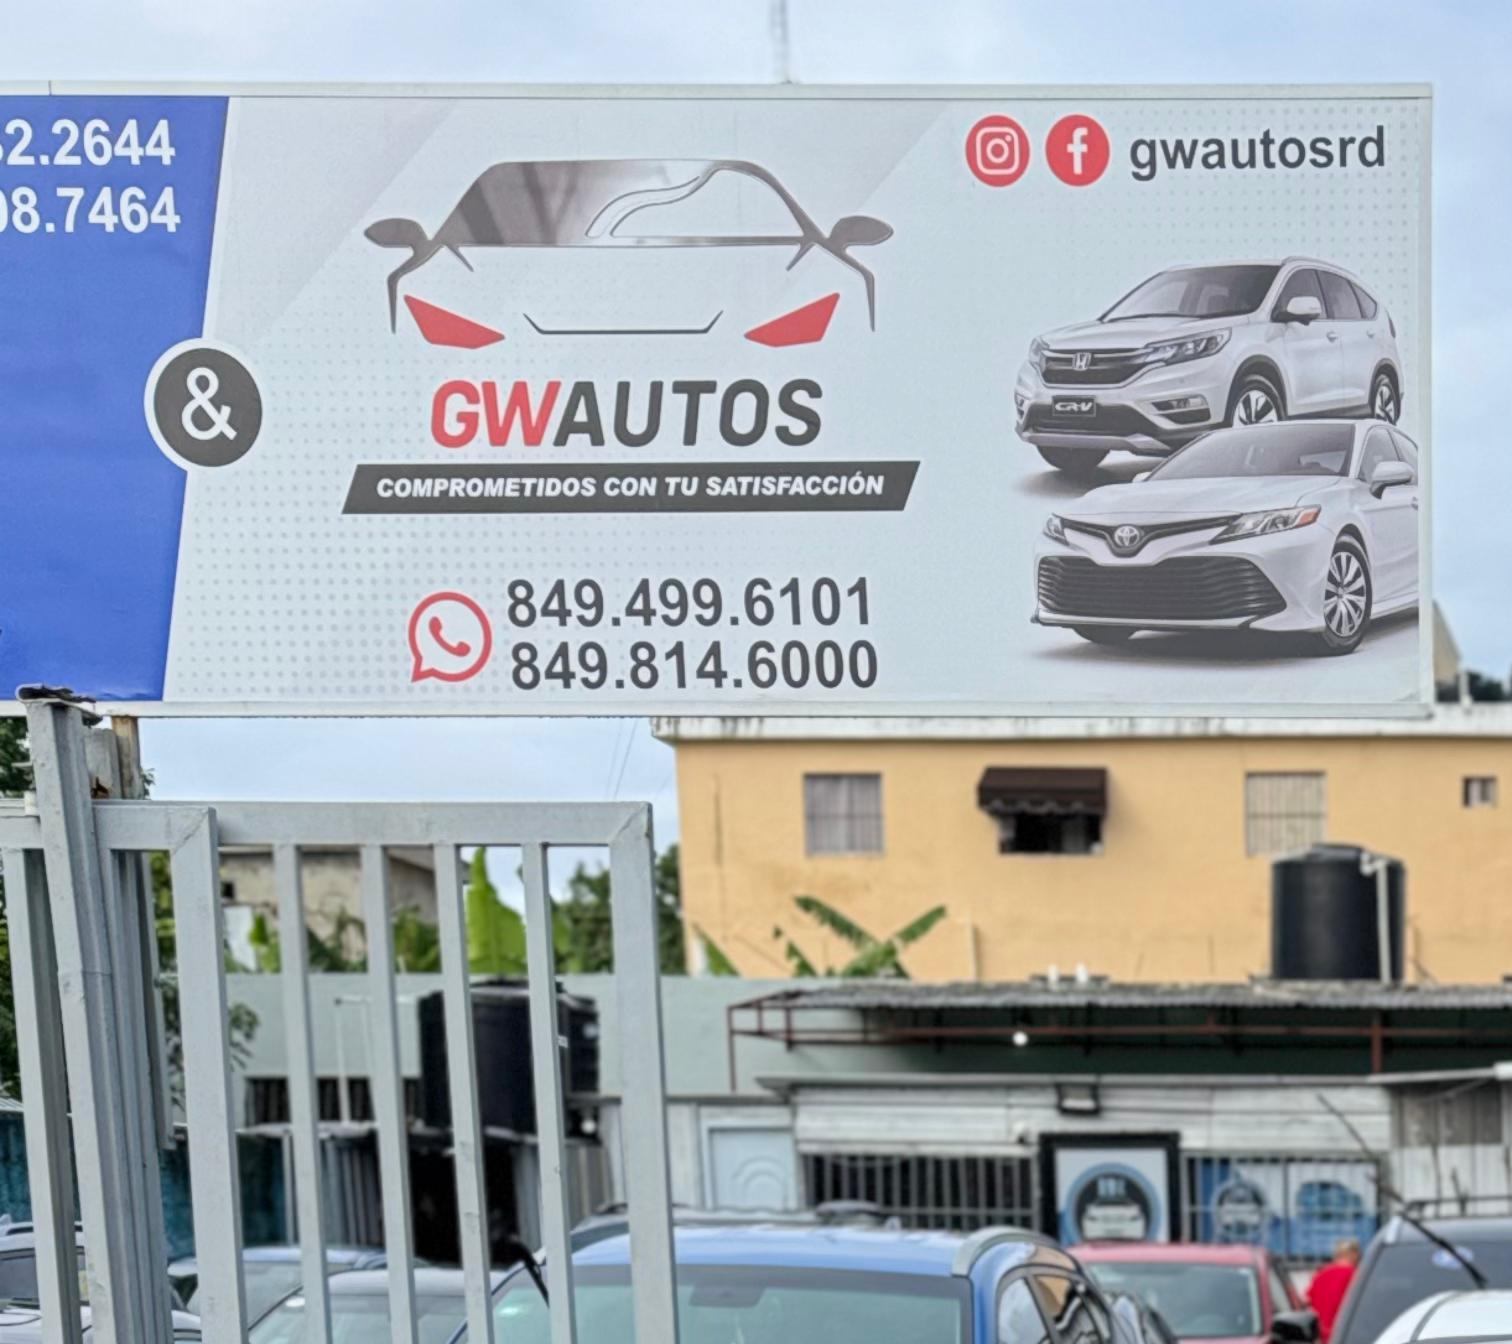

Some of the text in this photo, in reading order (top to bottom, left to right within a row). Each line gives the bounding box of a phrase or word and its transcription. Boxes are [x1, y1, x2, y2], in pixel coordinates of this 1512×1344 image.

[0, 118, 176, 166] 2.2644
[1130, 124, 1385, 182] gwautosrd
[181, 366, 238, 441] &
[431, 378, 823, 448] GWAUTOS
[376, 470, 885, 498] COMPROMETIDOS CON TU SATISFACCIÓN
[507, 576, 870, 628] 849.499.6101
[511, 639, 878, 691] 849.814.6000
